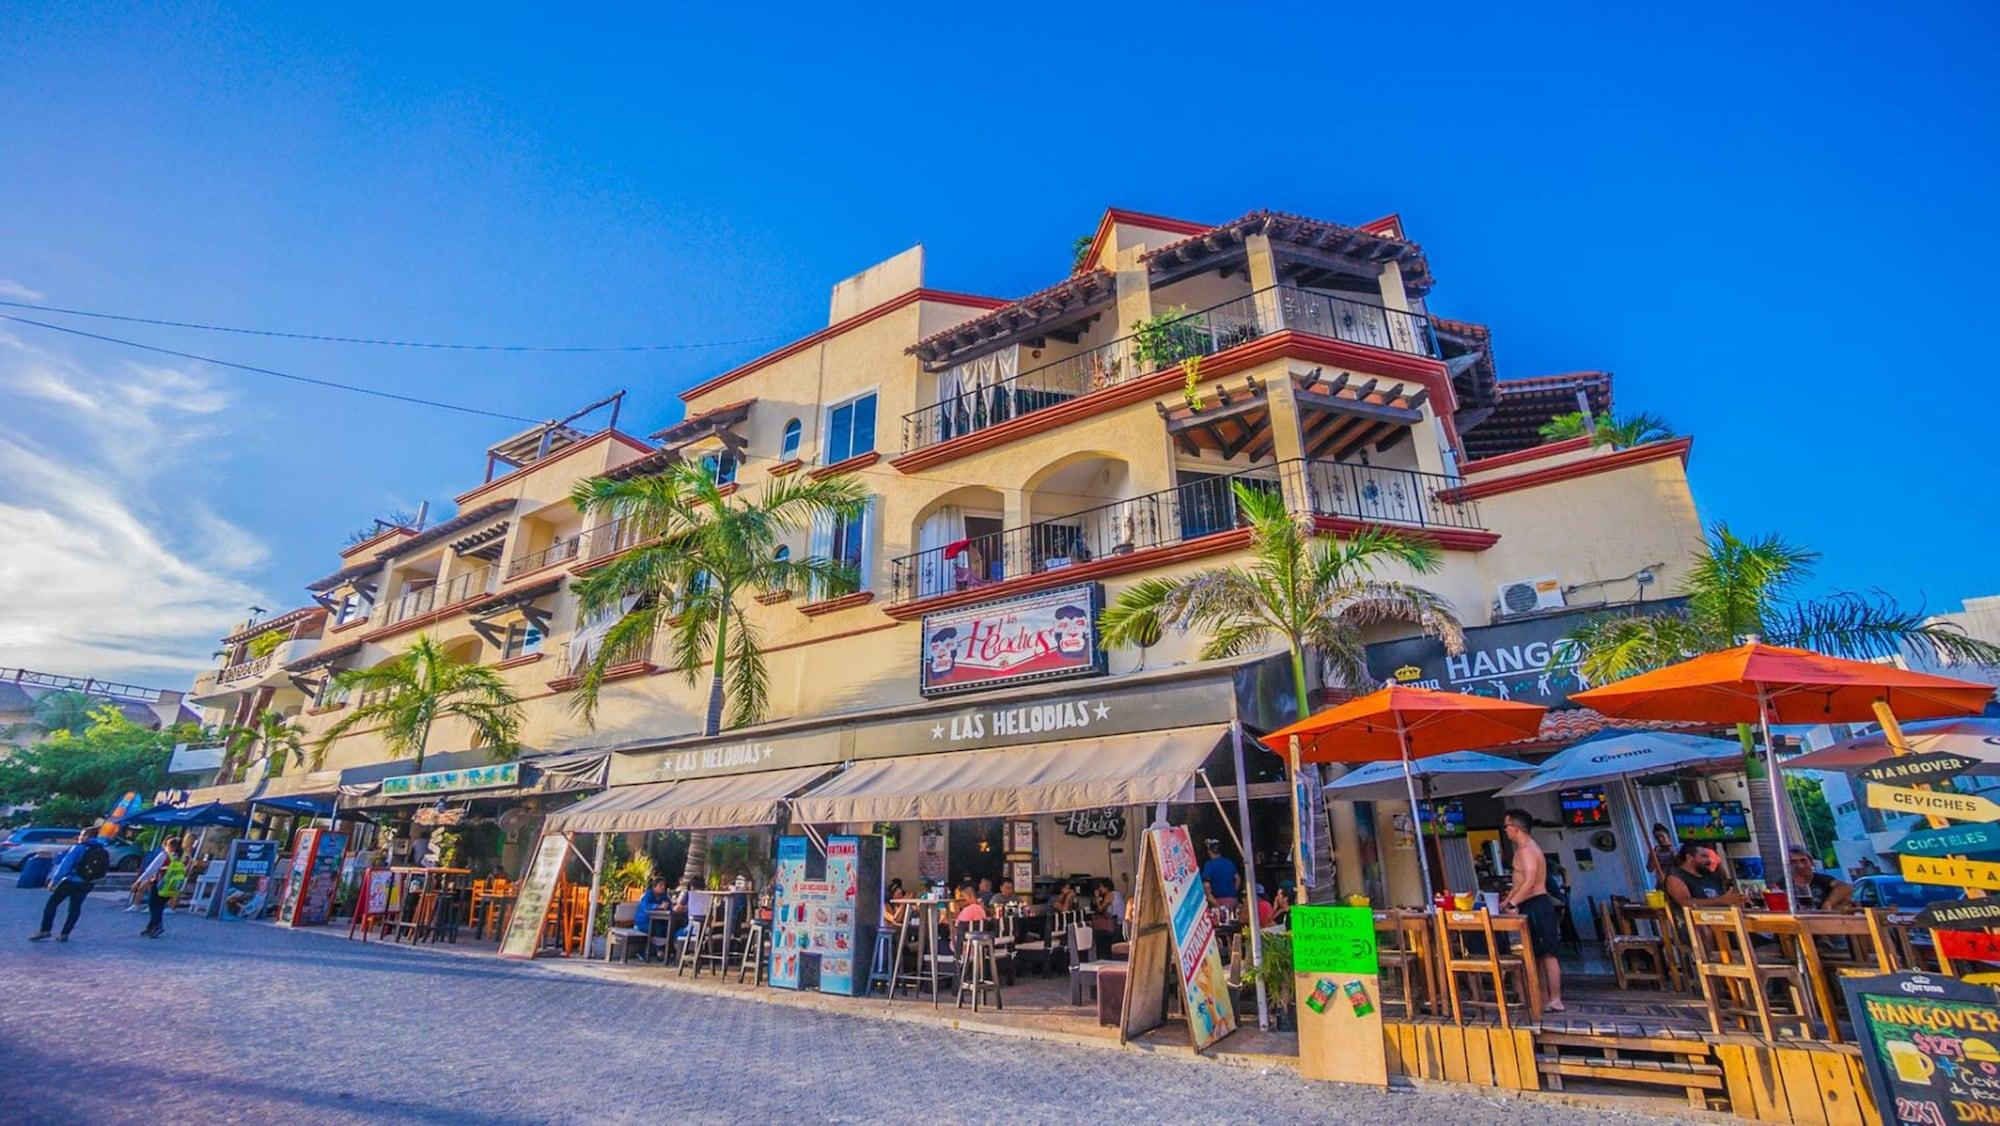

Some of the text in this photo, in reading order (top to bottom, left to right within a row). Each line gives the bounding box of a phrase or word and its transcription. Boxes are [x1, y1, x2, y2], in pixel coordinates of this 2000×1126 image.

[950, 701, 1090, 741] LAS HELODIAS
[676, 745, 760, 771] LAS HELODIAS
[1591, 748, 1653, 763] Corona
[1870, 758, 1963, 780] HANGOVER
[1893, 792, 1977, 812] CEVICHES
[1906, 832, 1987, 850] COCTELES
[1933, 905, 2000, 922] HAMBUR
[1181, 912, 1214, 977] BOTANAS
[1900, 981, 1945, 994] Corona
